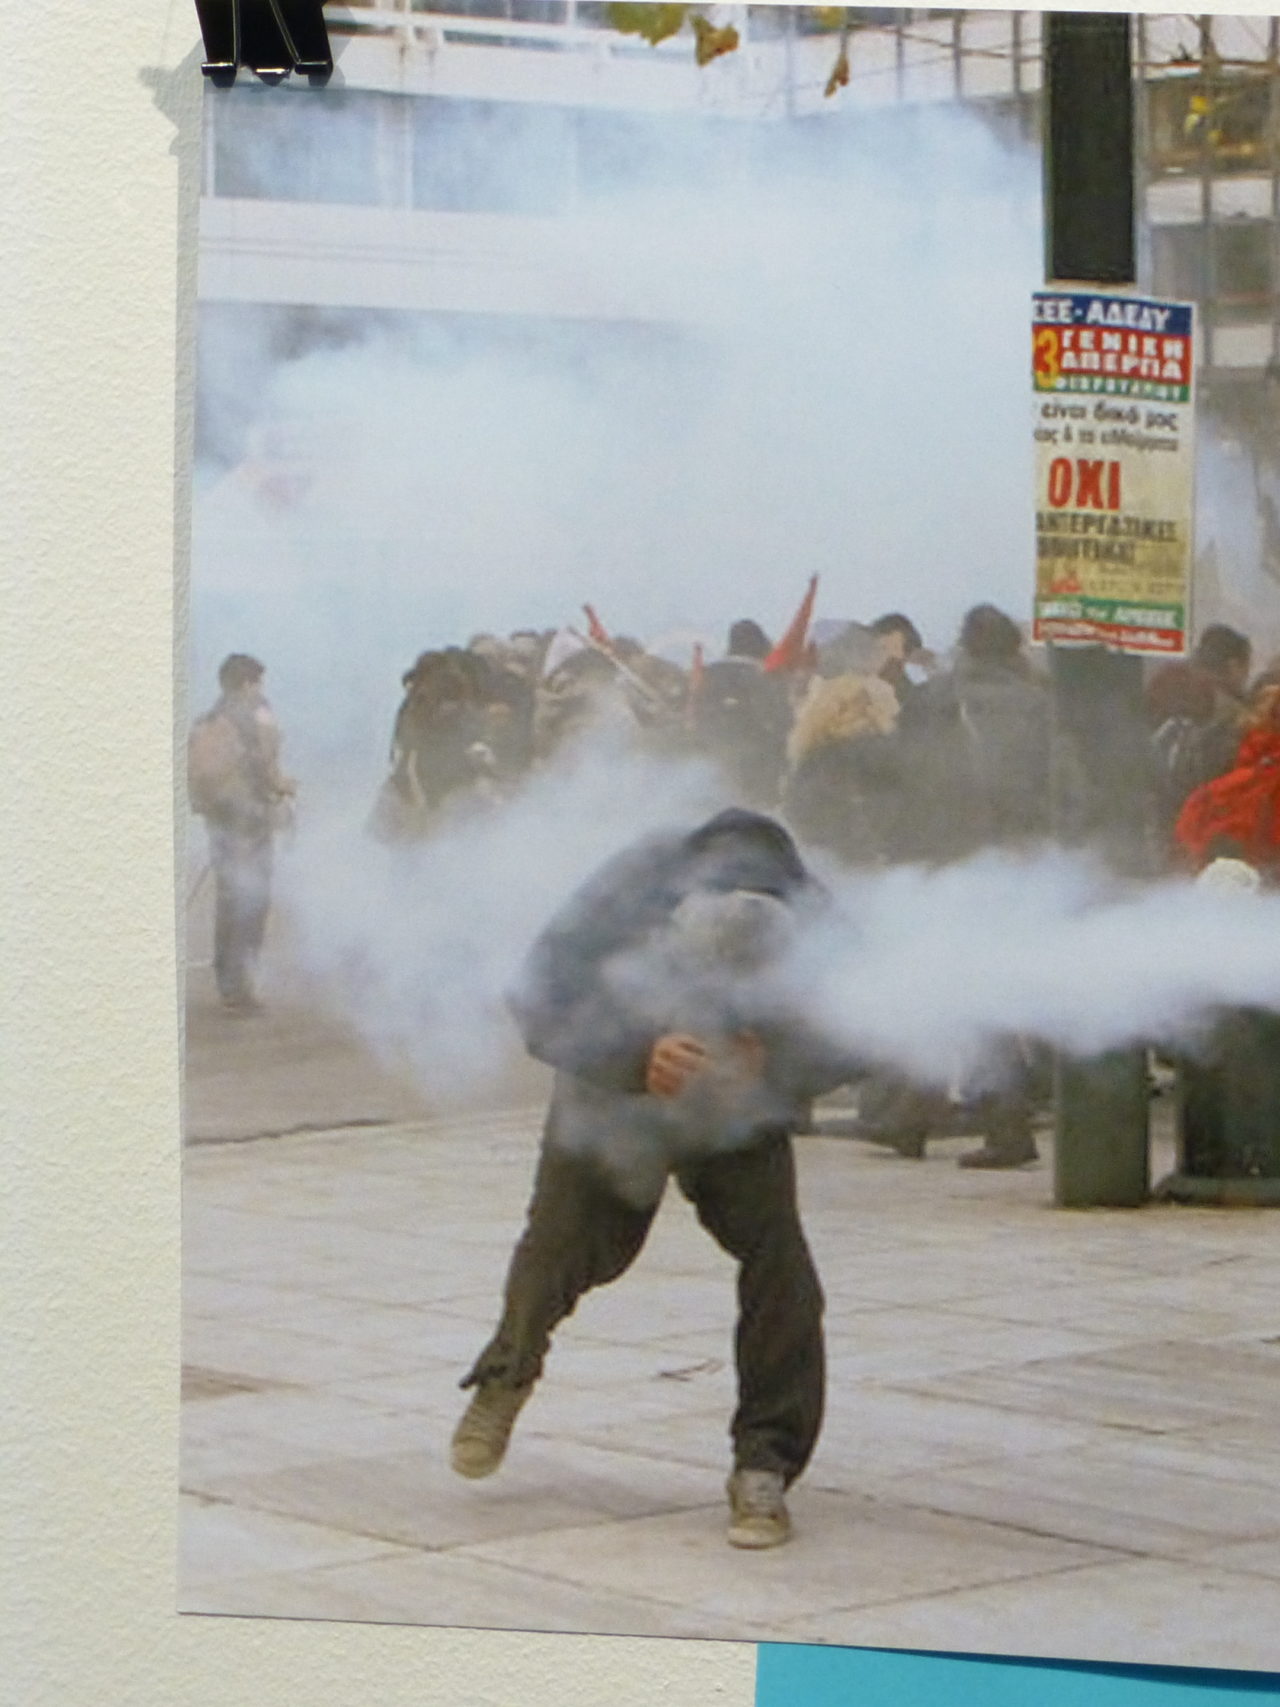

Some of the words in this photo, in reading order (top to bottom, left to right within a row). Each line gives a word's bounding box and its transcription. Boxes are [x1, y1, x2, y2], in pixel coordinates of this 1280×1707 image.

[1062, 329, 1184, 360] ΓΕΝΙΚΗ
[1061, 351, 1183, 380] ΑΠΕΡΓΙΑ
[1048, 457, 1121, 511] ΟΧΙ
